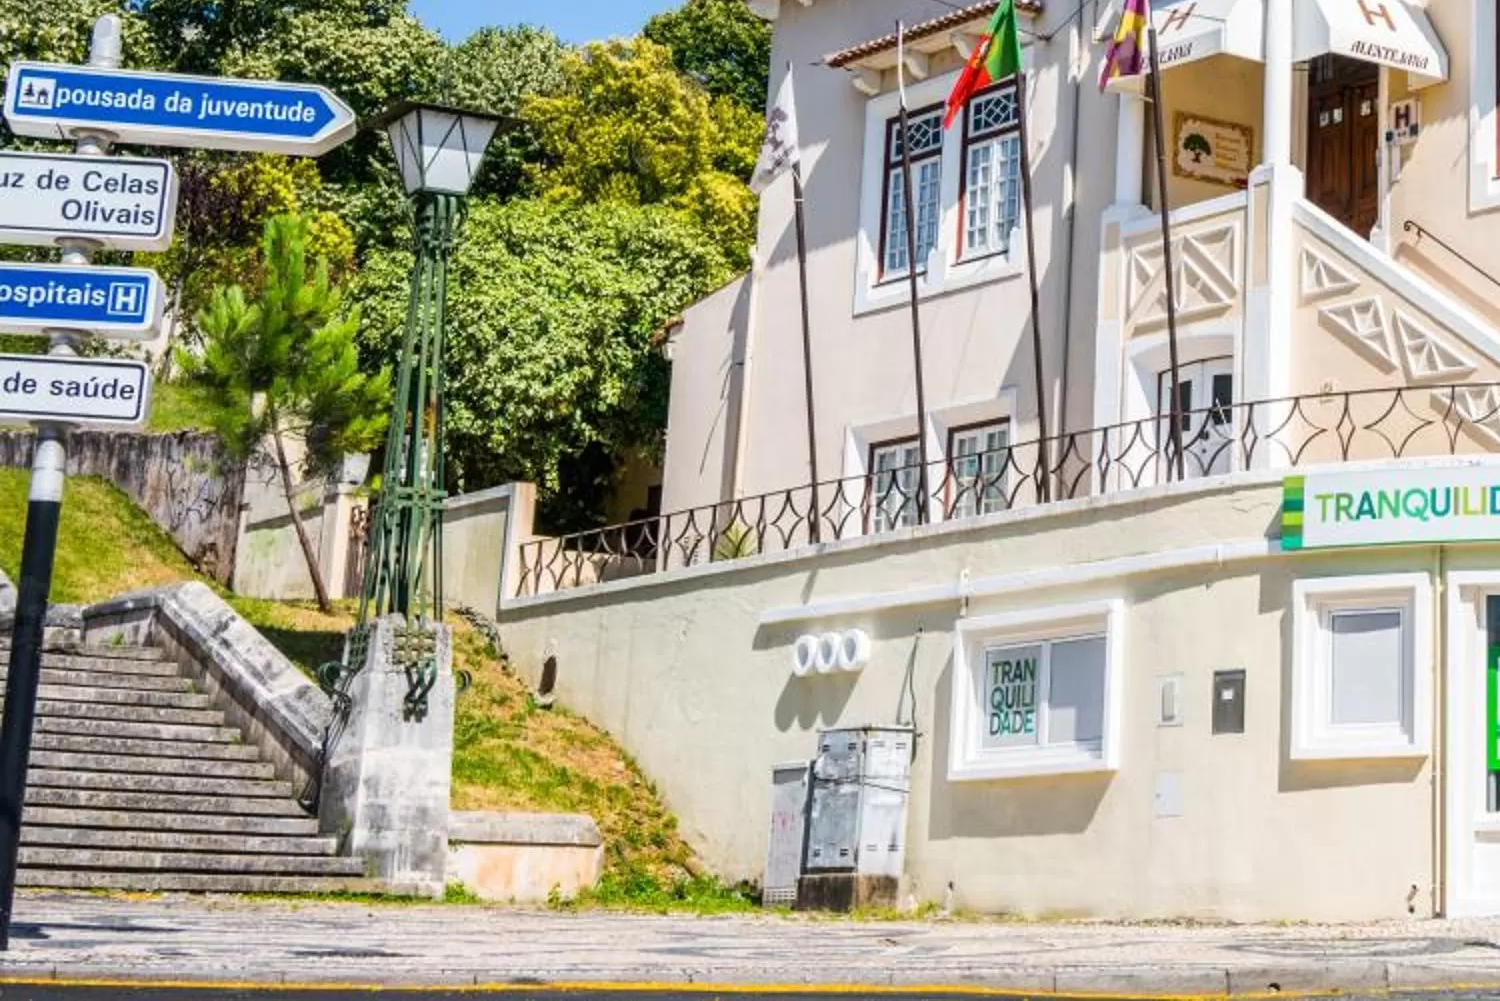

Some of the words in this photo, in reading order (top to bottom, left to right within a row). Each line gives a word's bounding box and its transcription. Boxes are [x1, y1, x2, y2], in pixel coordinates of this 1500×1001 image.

[1158, 2, 1197, 35] H
[55, 87, 156, 111] pousada
[164, 90, 193, 113] da
[197, 92, 317, 123] juventude
[0, 172, 25, 188] uz
[36, 168, 70, 191] de
[83, 170, 159, 196] Celas
[61, 198, 156, 226] Olivais
[0, 281, 107, 308] ospitais
[3, 371, 37, 395] de
[49, 376, 135, 400] saúde
[991, 657, 1037, 685] TRAN
[990, 684, 1035, 713] QUILI
[989, 710, 1034, 736] DADE
